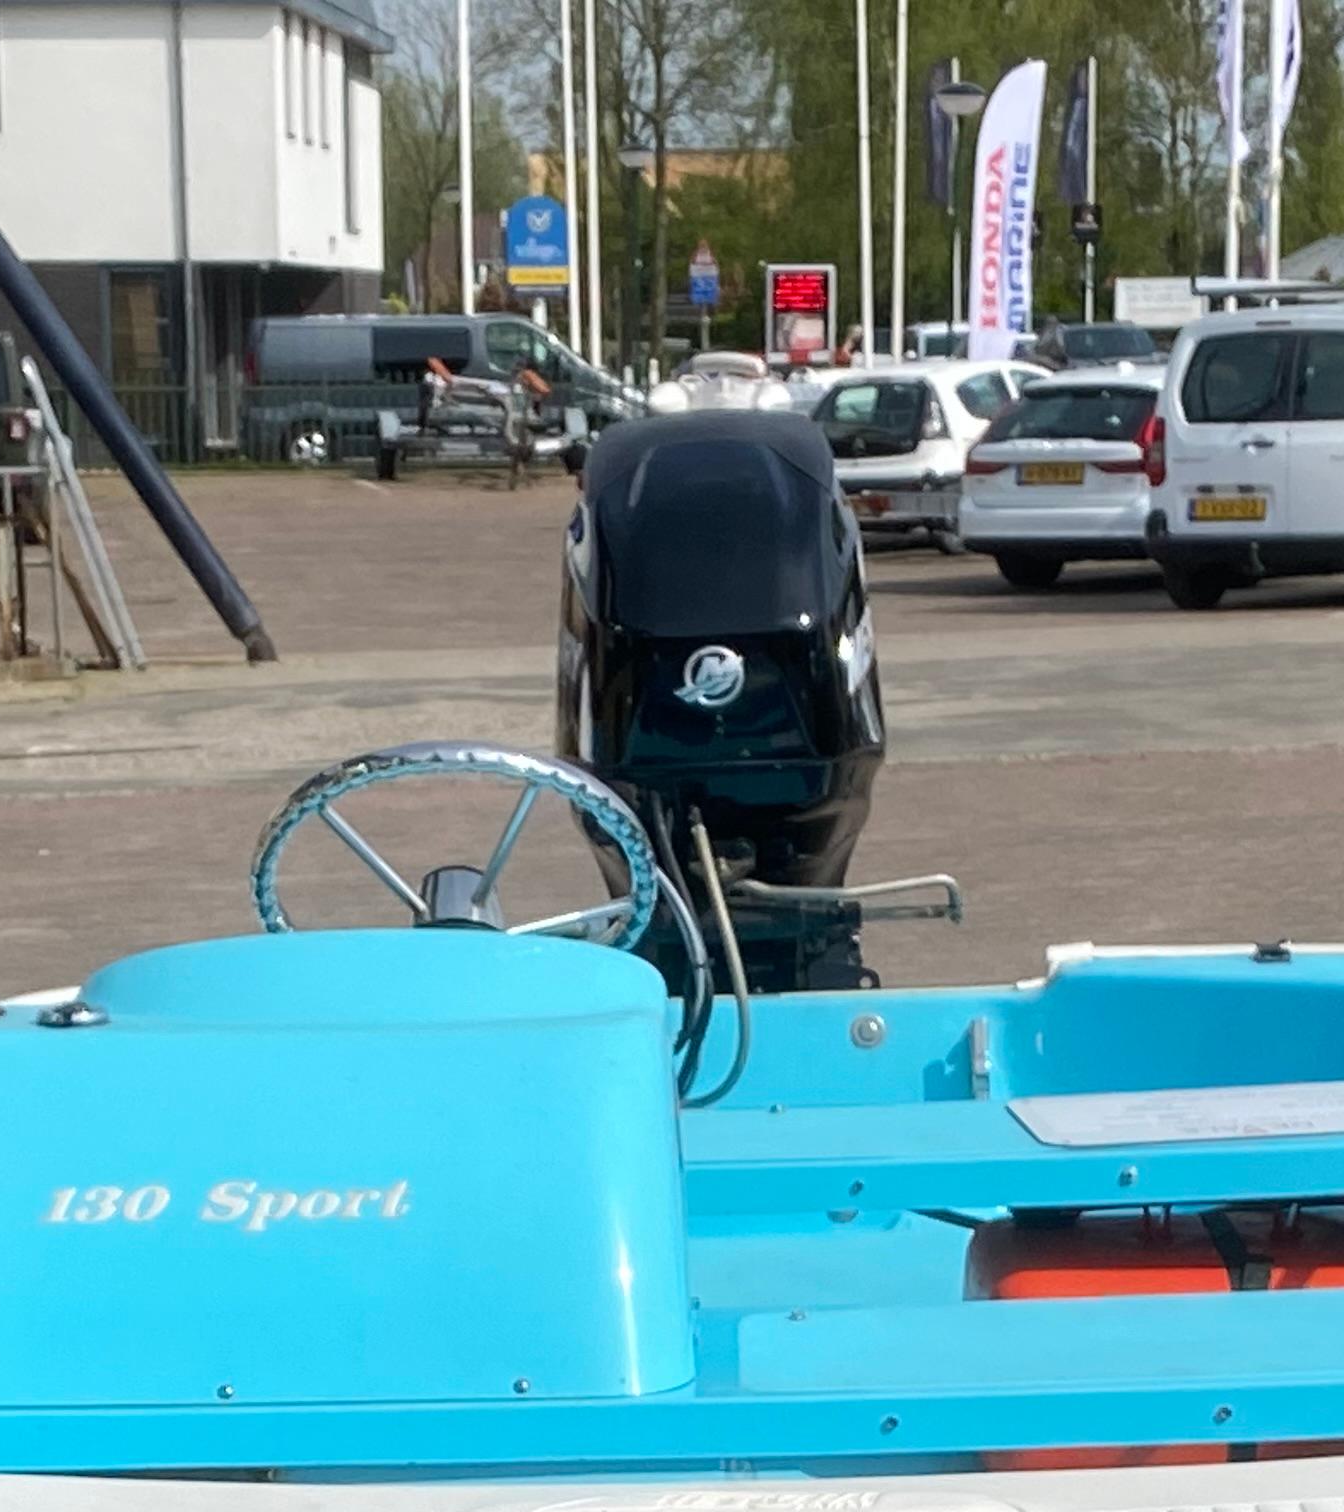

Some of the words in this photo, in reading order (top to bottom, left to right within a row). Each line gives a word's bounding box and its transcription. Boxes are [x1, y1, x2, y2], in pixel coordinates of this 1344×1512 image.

[981, 144, 1006, 330] HONDA
[46, 1185, 171, 1223] 130
[199, 1180, 412, 1232] Sport
